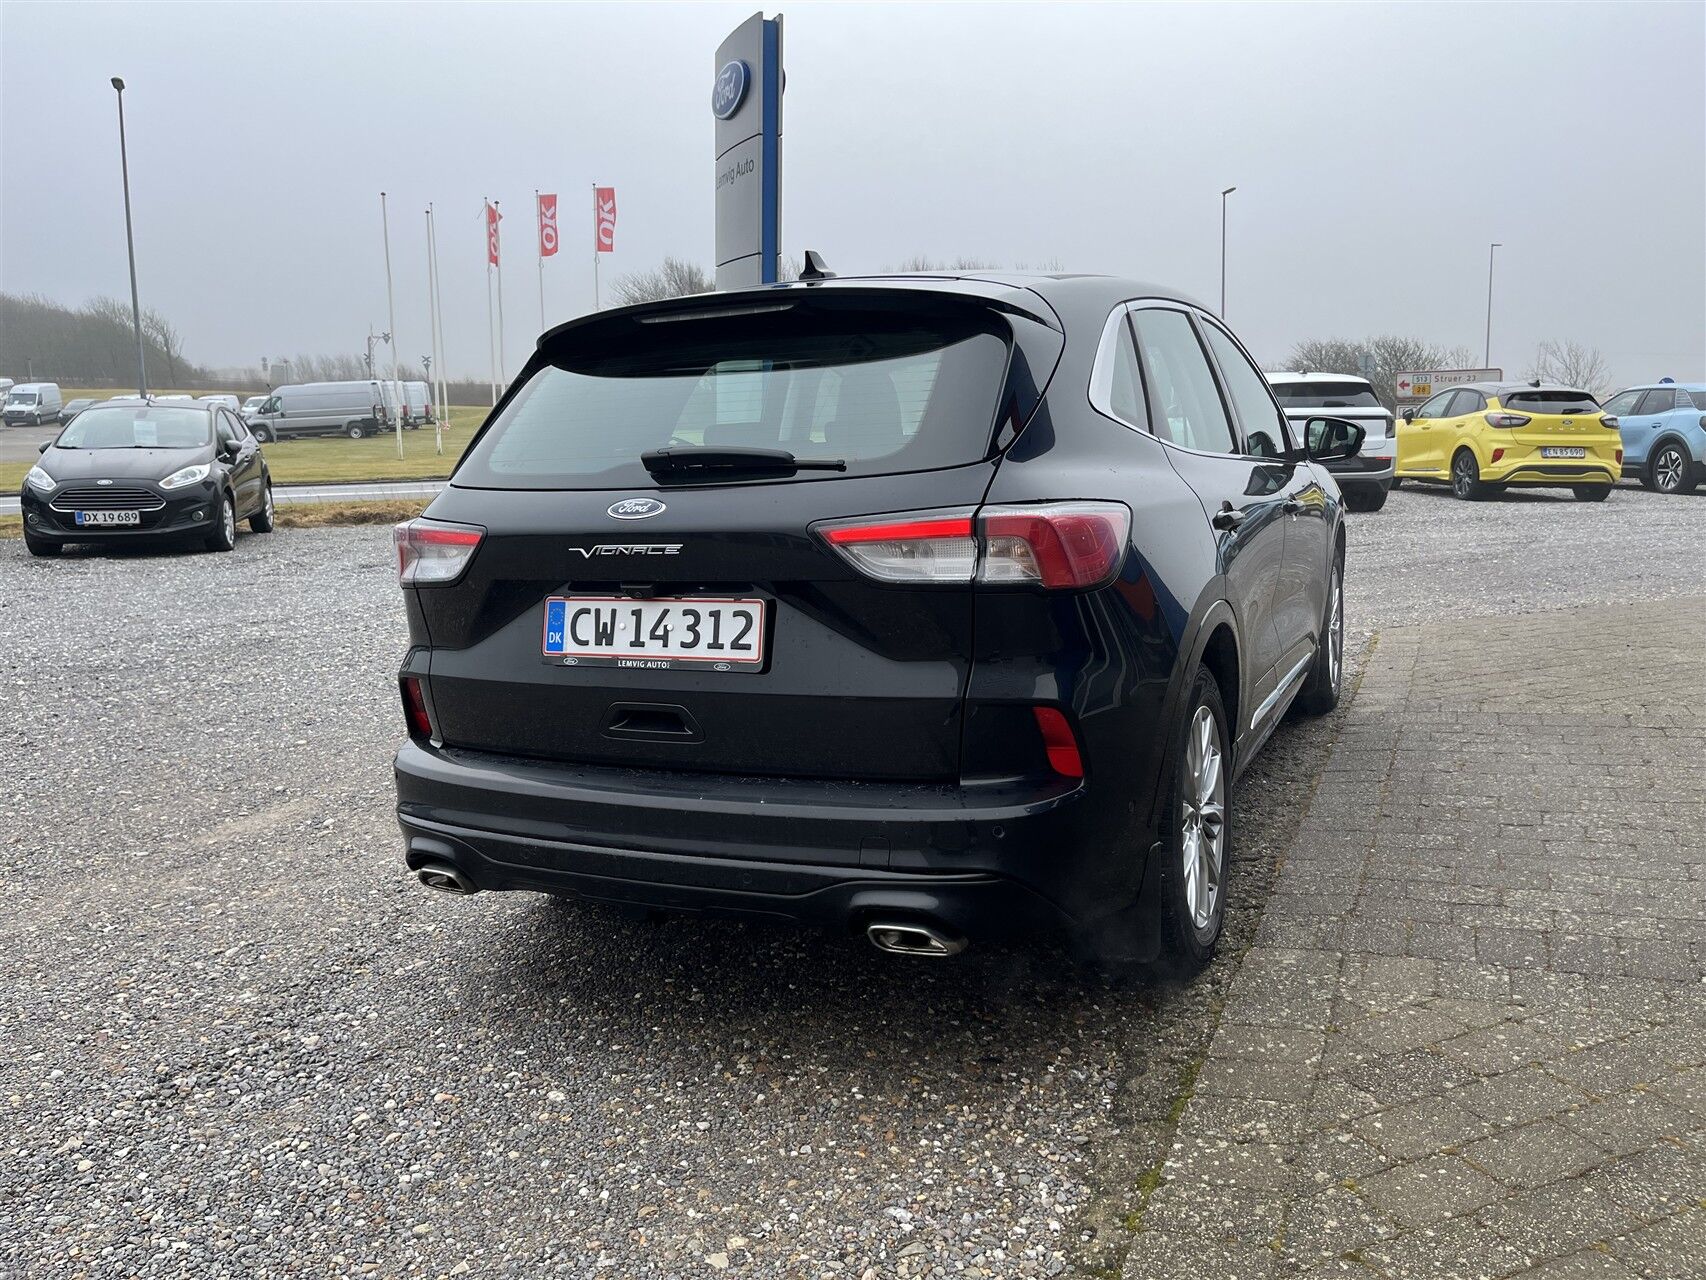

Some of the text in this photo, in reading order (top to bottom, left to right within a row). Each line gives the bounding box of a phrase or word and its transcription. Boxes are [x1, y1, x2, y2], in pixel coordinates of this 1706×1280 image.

[716, 158, 755, 190] emvig Auto
[541, 204, 556, 250] OK
[599, 197, 614, 245] OK
[1434, 375, 1462, 383] Struer
[618, 500, 652, 513] Ford
[84, 512, 99, 523] DX
[102, 512, 115, 523] 19
[117, 512, 138, 523] 689
[568, 543, 684, 559] VIGNALE
[570, 607, 617, 647] CW
[549, 631, 562, 644] DK
[617, 660, 646, 669] LEMVIG
[646, 662, 667, 670] AUTO
